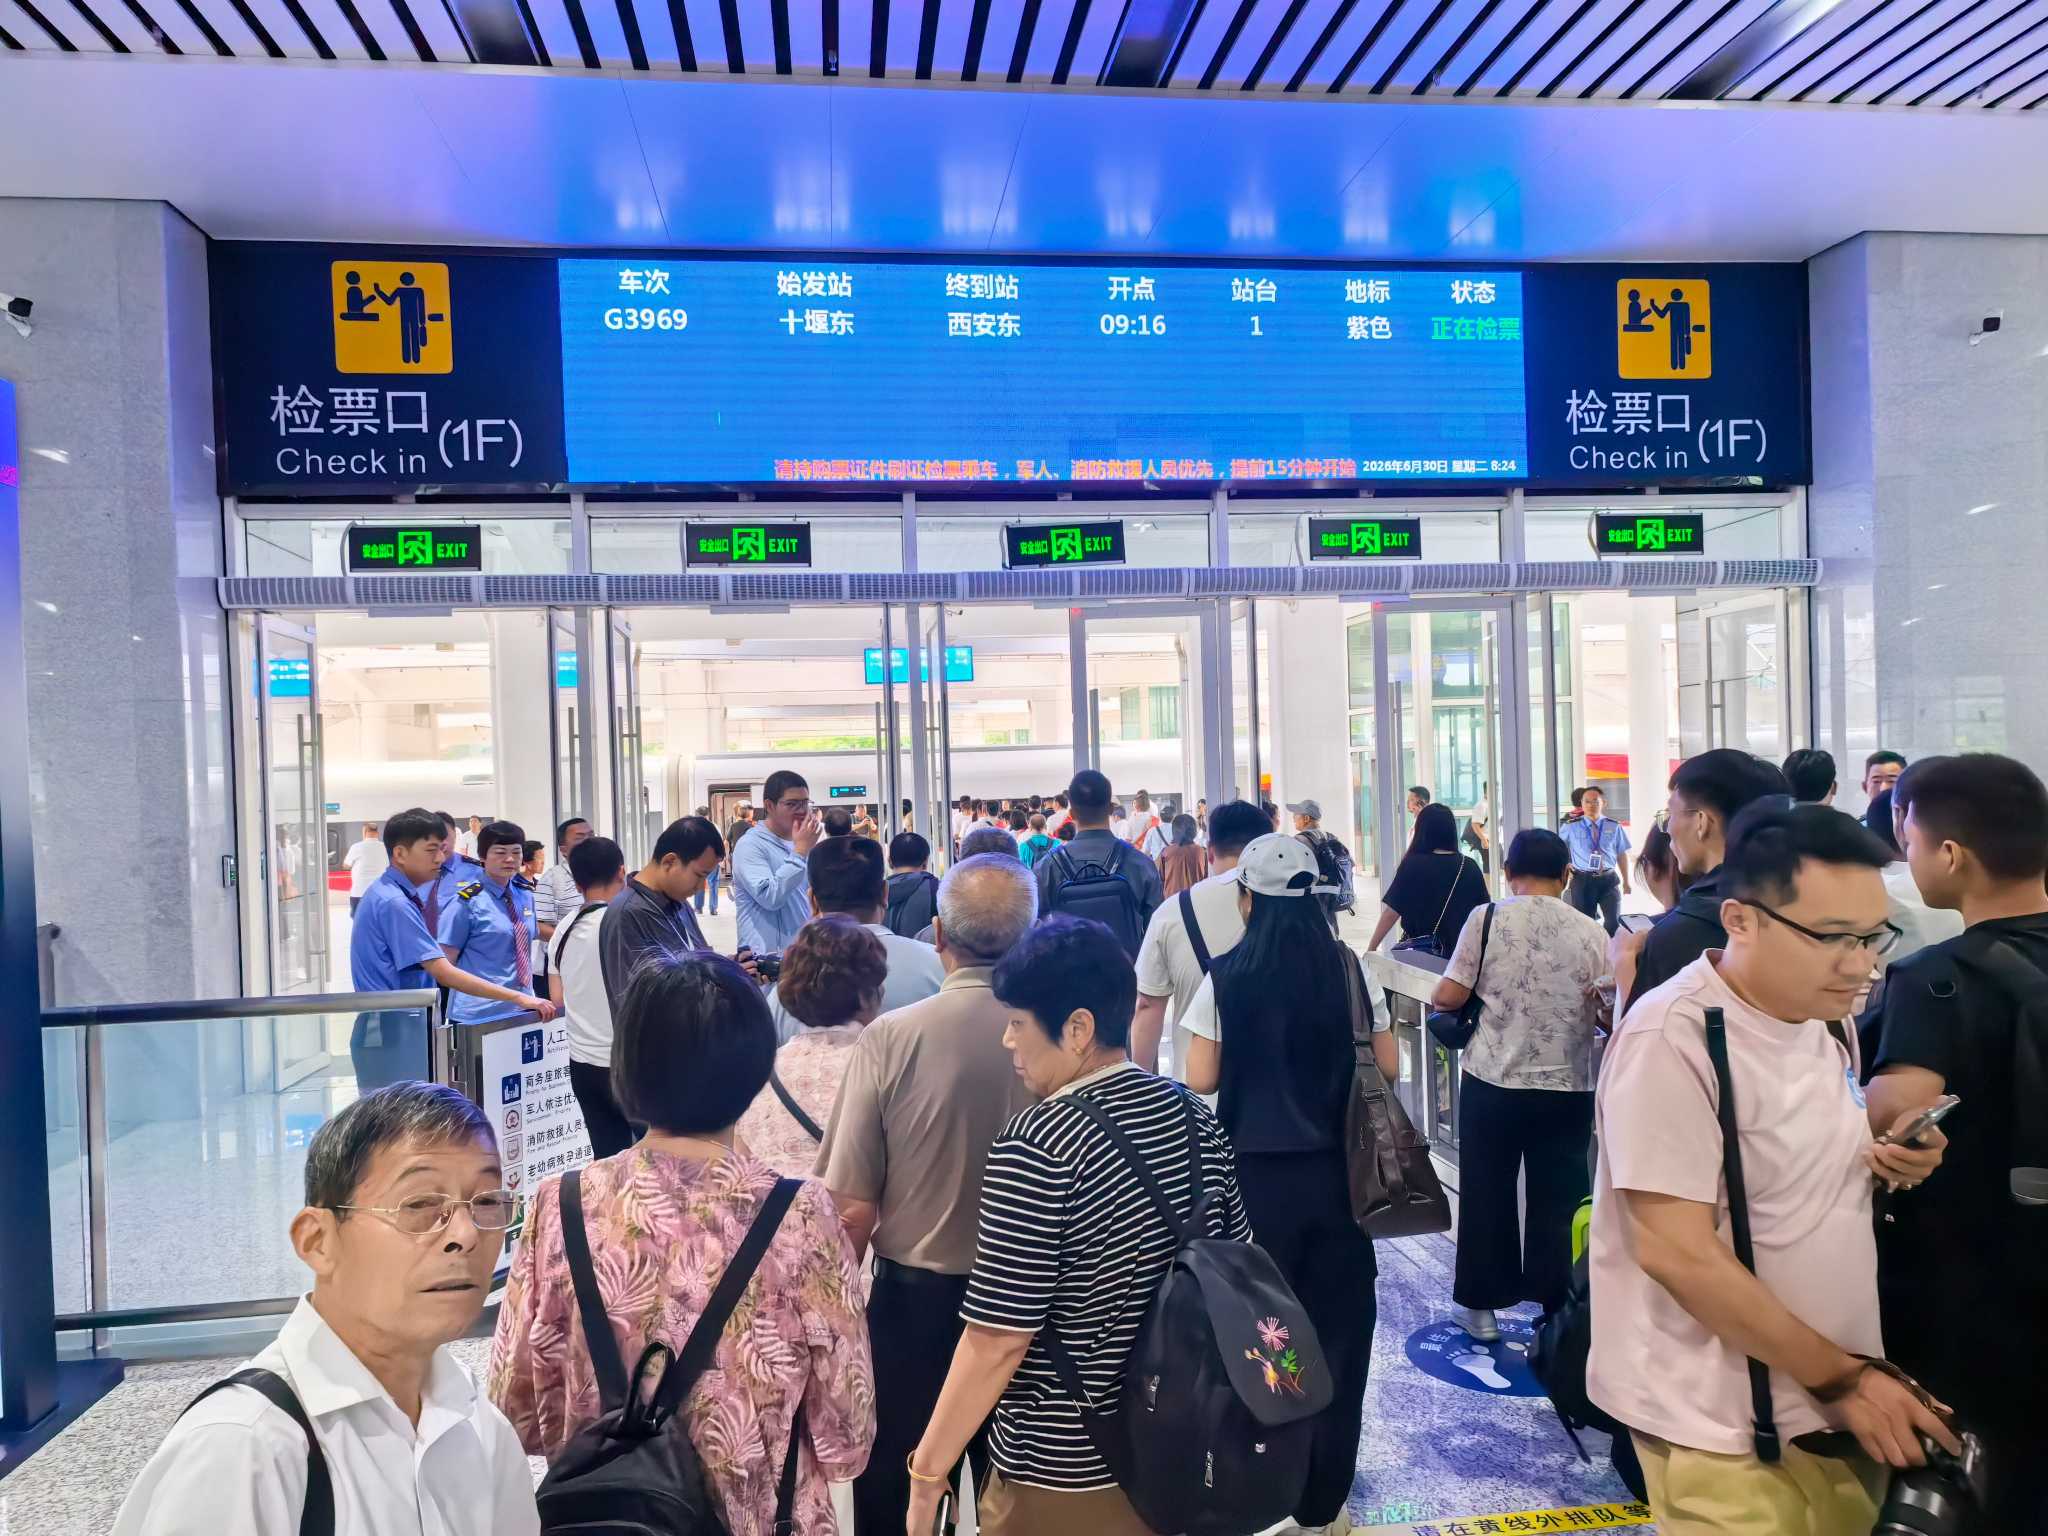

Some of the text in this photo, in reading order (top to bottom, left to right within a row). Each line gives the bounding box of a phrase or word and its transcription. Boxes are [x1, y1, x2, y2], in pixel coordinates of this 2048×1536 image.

[618, 269, 1496, 304] 车次 始发站 终到站 开点 站台 地标 状态
[604, 308, 1520, 341] G3969 十堰东 西安东 09:16 1 紫色 正在检票
[270, 384, 429, 437] 检票口
[1565, 389, 1690, 435] 检票口
[439, 419, 523, 469] (1F)
[1698, 419, 1767, 463] (1F)
[276, 448, 426, 475] Check in
[1569, 446, 1688, 469] Check in
[768, 537, 798, 553] EXIT
[1085, 536, 1112, 552] EXIT
[1384, 532, 1410, 547] EXIT
[1667, 528, 1693, 542] EXIT
[436, 543, 468, 559] EXIT
[547, 1029, 569, 1046] 人工
[527, 1118, 587, 1148] 消防救援人员
